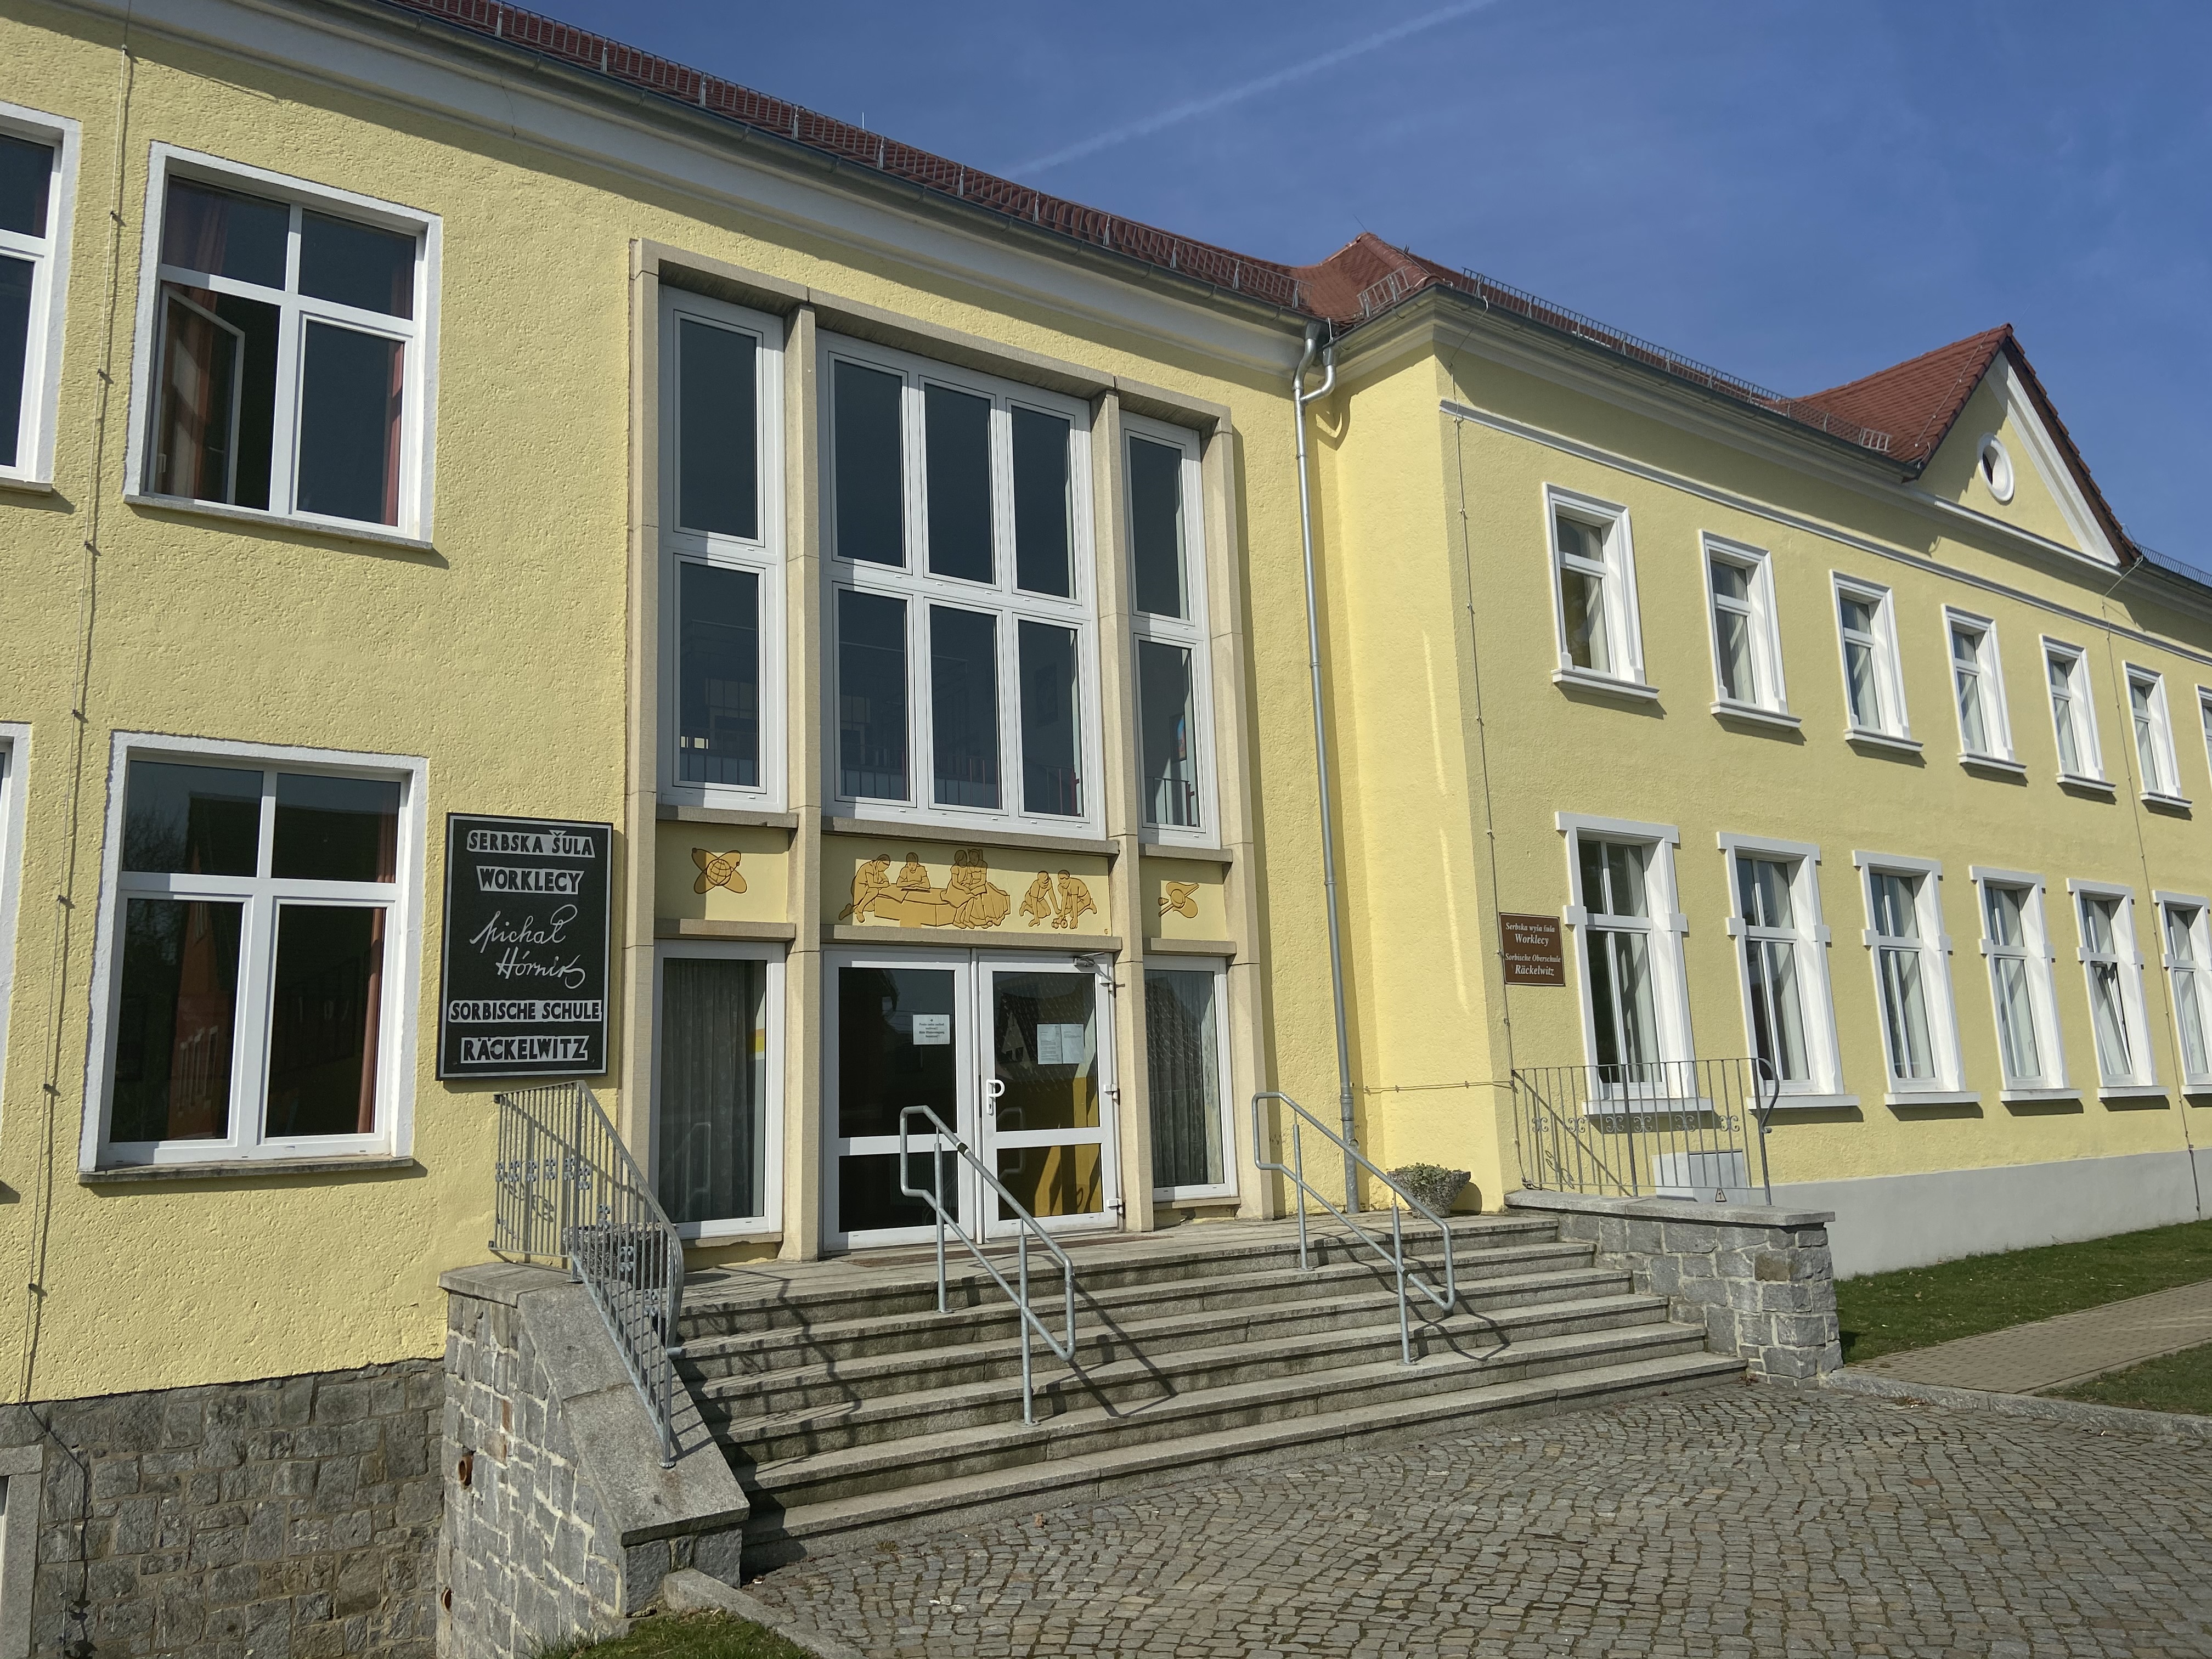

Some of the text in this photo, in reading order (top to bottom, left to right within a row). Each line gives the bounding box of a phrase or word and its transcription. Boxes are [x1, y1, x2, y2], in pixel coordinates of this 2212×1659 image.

[468, 831, 593, 856] SERBSKA ŠULA
[479, 868, 581, 893] WORKLECY
[1505, 922, 1555, 933] Serbska wyša šula
[1515, 933, 1549, 947] Worklecy
[1505, 953, 1561, 963] Sorbische Oberschule
[1515, 964, 1555, 977] Räckelwitz
[450, 1002, 600, 1020] SORBISCHE SCHULE
[463, 1037, 586, 1061] RÄCKELWITZ
